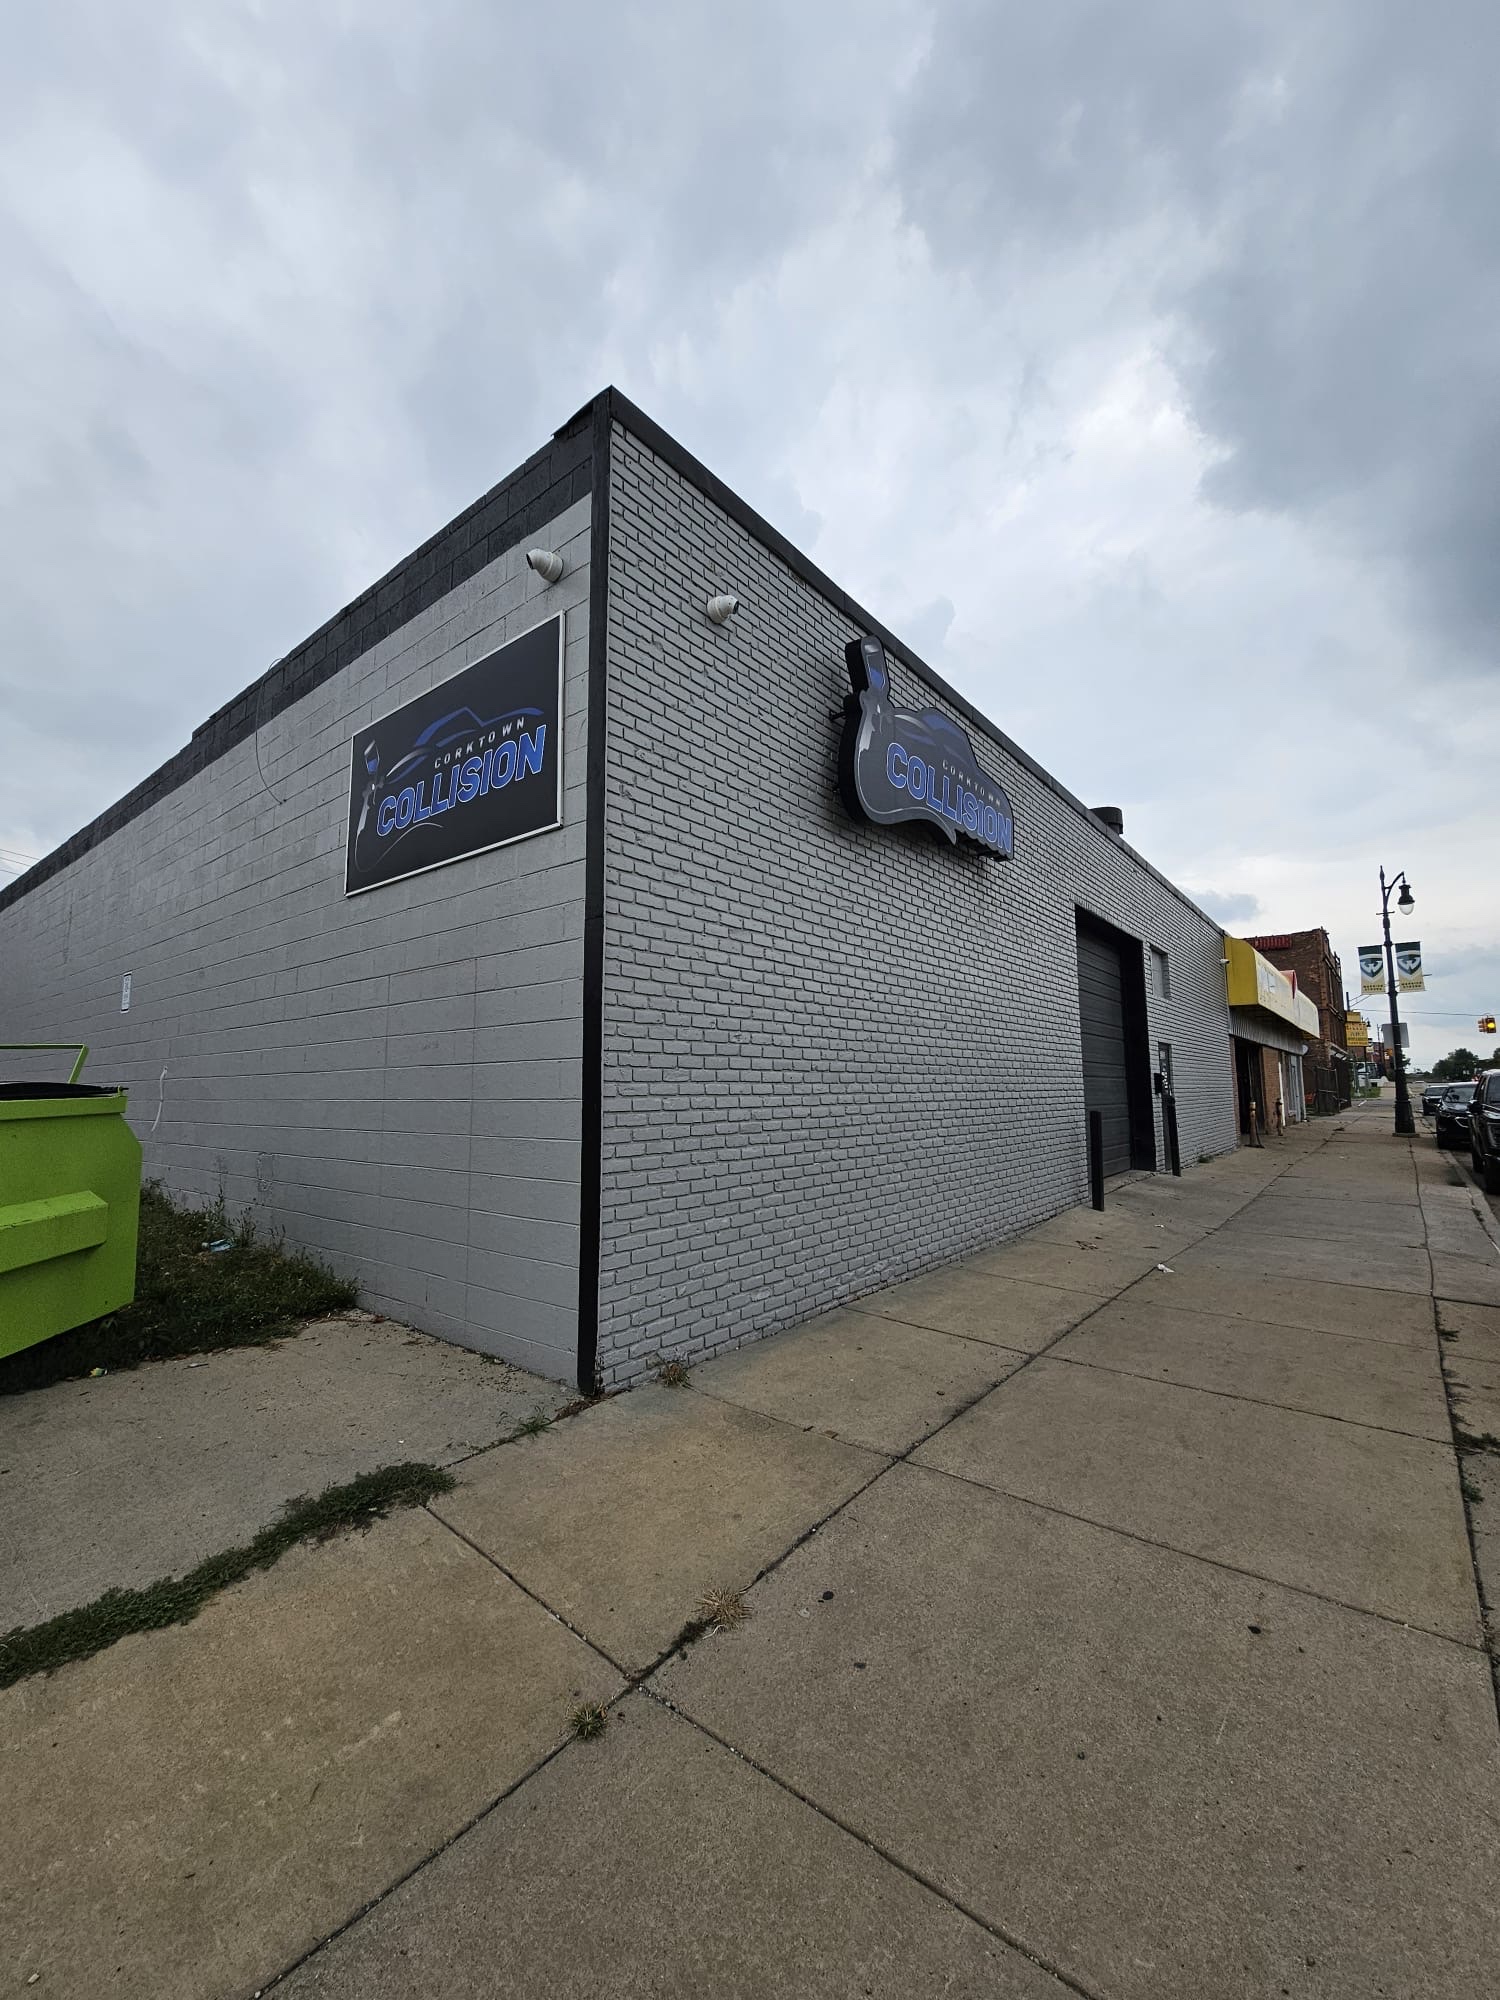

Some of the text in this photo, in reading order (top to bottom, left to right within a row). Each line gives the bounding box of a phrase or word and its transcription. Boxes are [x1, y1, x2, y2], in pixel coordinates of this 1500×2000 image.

[376, 724, 547, 837] COLLISION
[434, 717, 525, 769] CORKTOWN
[887, 742, 1012, 854] COLLISION
